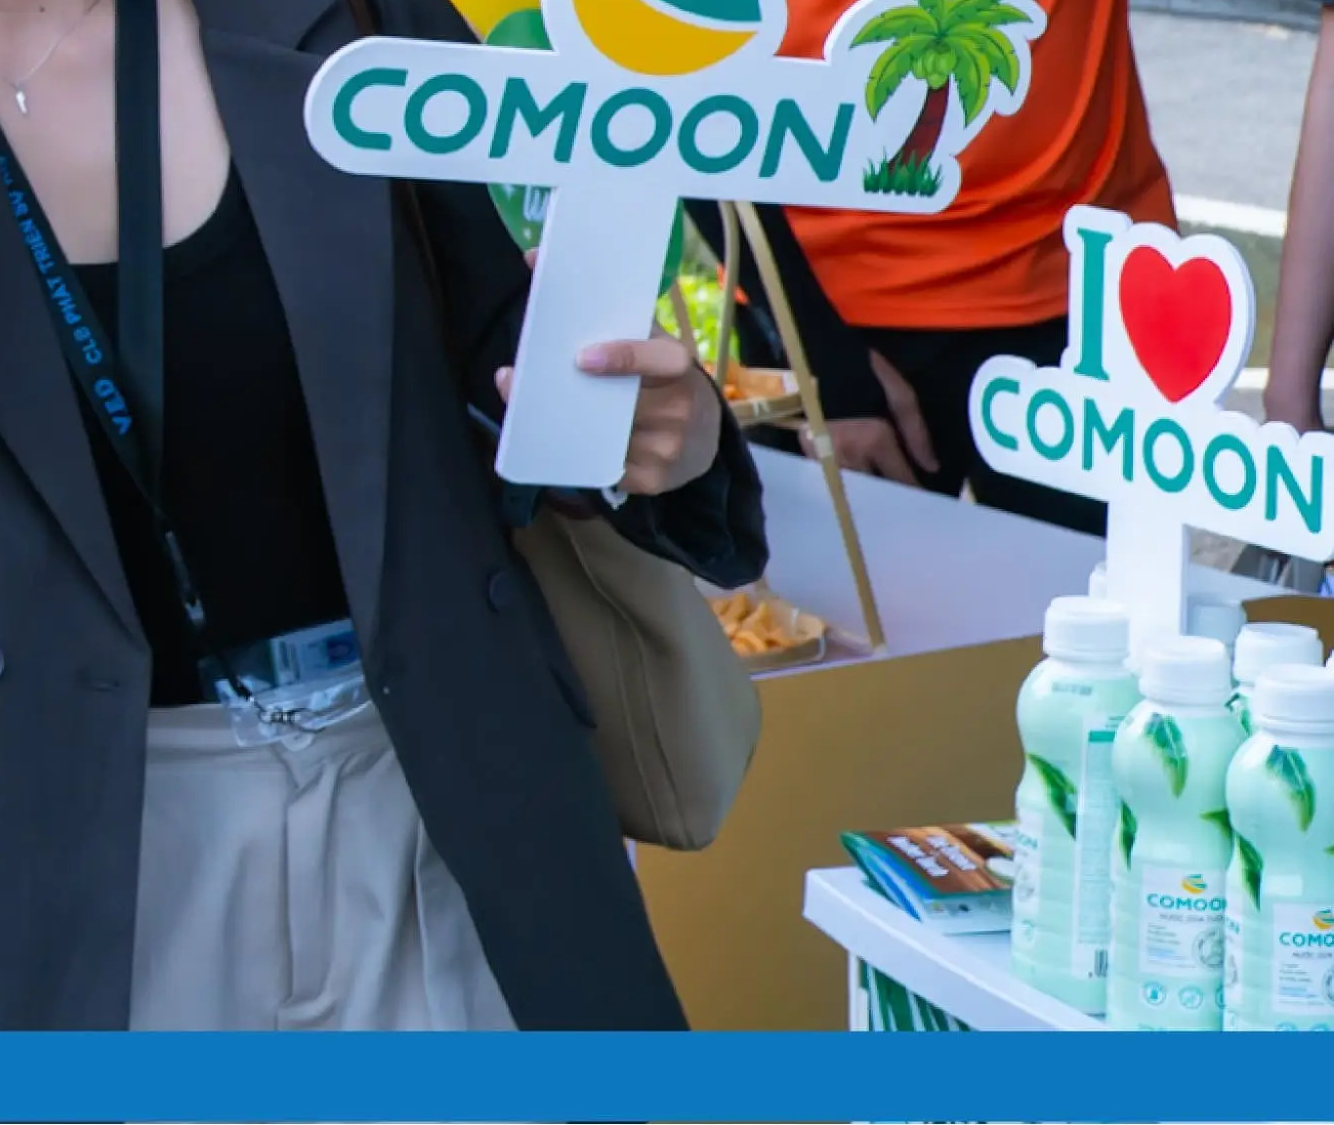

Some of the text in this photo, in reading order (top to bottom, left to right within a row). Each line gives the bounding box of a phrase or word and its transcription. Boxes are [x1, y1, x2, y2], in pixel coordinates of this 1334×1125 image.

[332, 68, 855, 183] COMOON
[1074, 229, 1112, 381] I
[73, 326, 103, 364] CLB
[981, 376, 1324, 534] COMOON
[1146, 892, 1227, 912] COMOO
[1279, 931, 1334, 947] COMO
